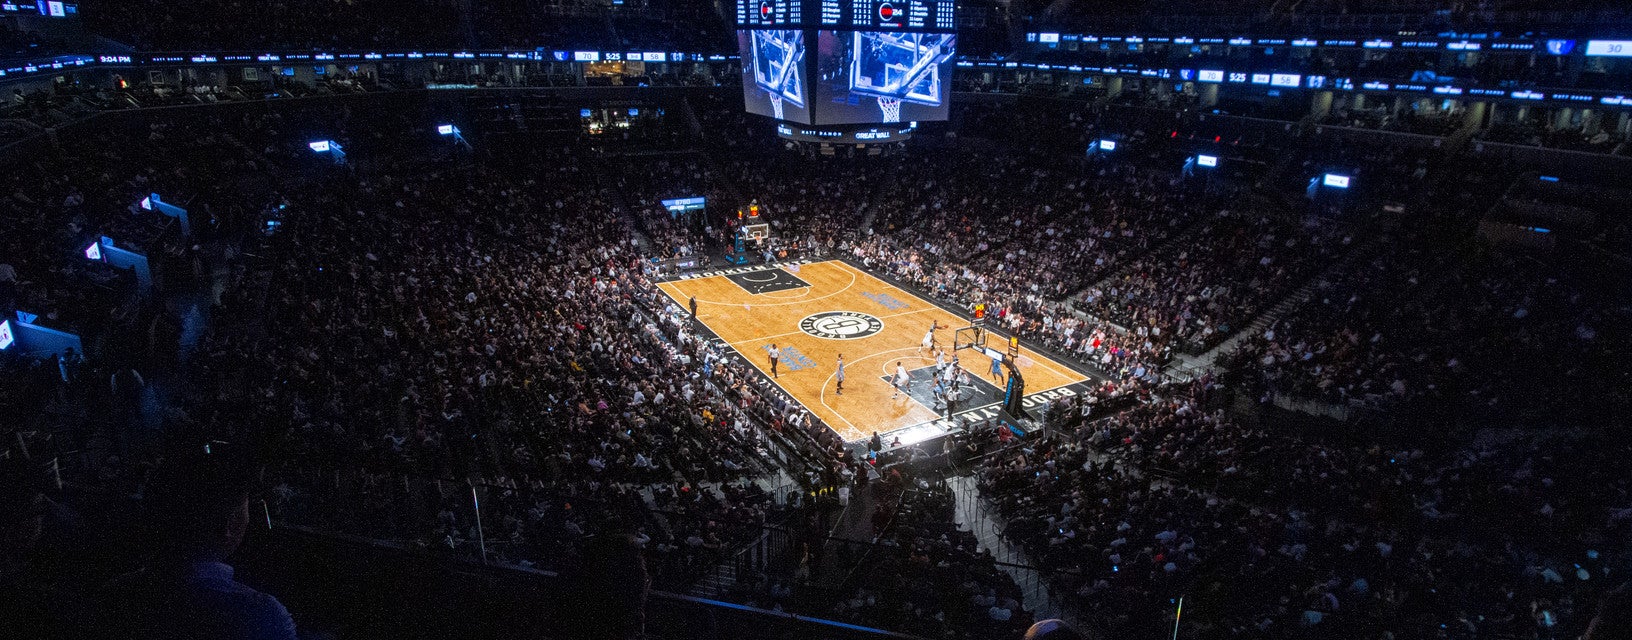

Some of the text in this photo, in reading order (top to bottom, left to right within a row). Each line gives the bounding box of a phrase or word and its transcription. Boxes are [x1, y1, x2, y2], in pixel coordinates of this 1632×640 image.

[1607, 45, 1622, 53] 30
[1229, 72, 1247, 82] 5:25
[962, 387, 1077, 423] BROOLYN
